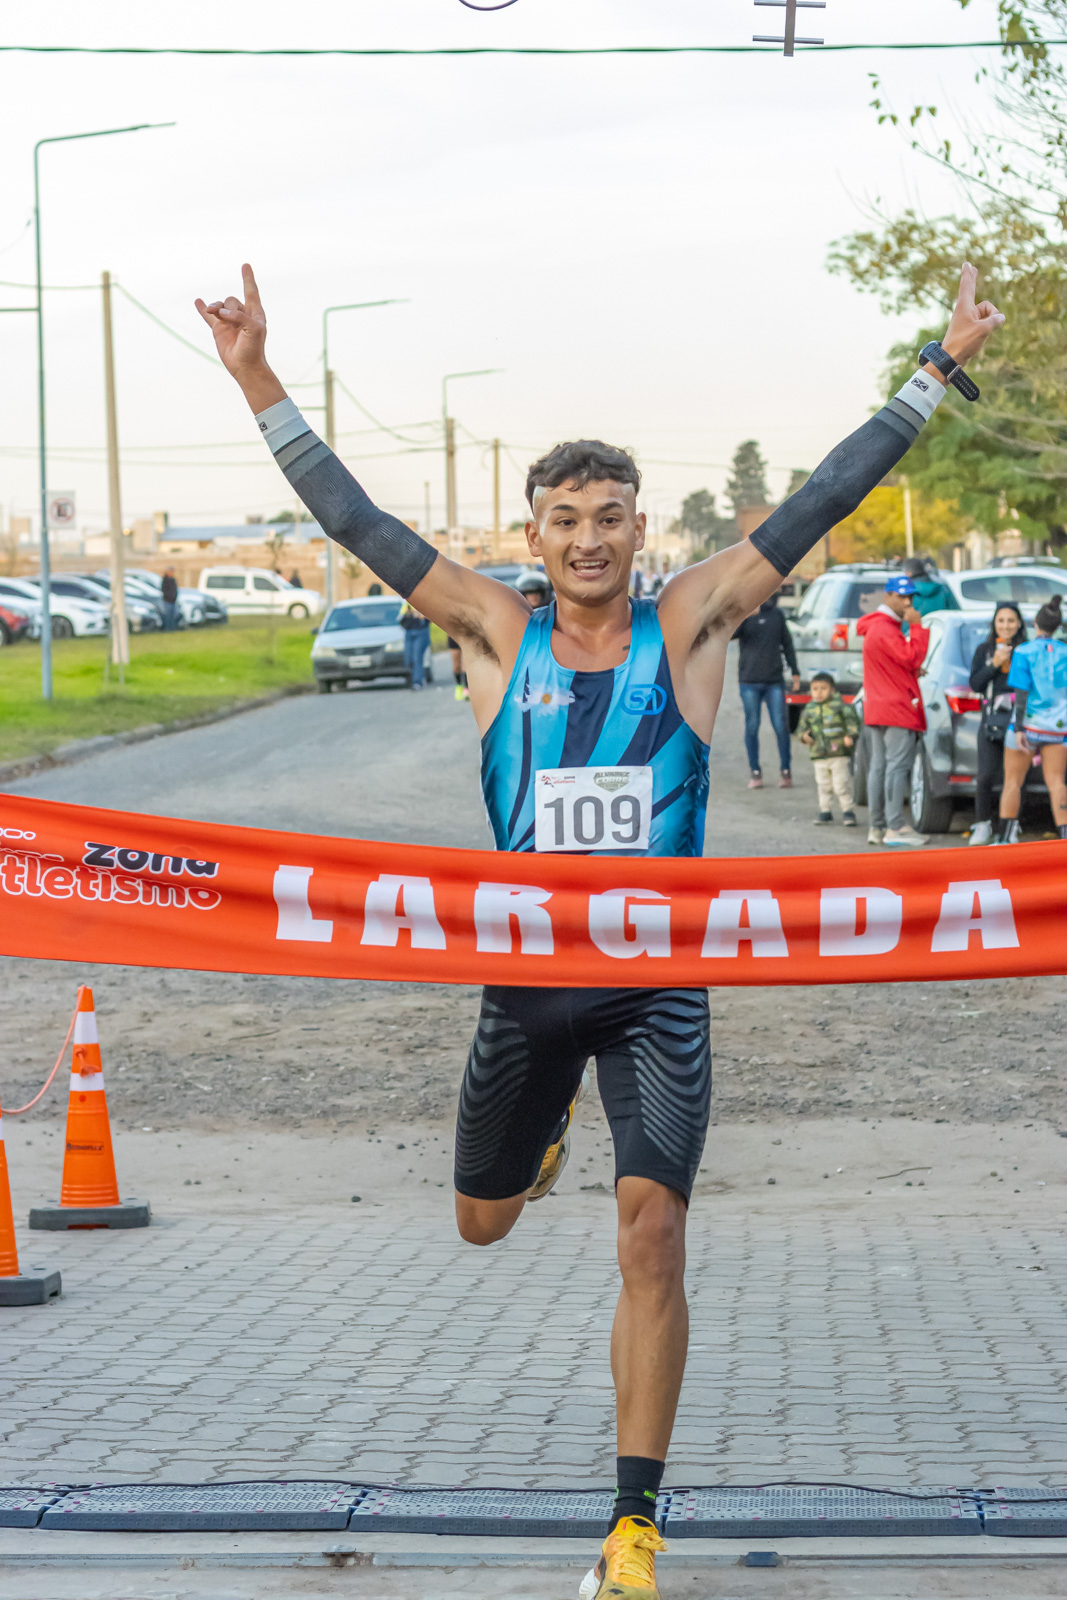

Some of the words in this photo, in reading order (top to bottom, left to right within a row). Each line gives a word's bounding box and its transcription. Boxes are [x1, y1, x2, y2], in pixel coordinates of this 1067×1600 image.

[543, 794, 641, 846] 109
[82, 841, 220, 878] zona
[272, 864, 1021, 960] LARGADA
